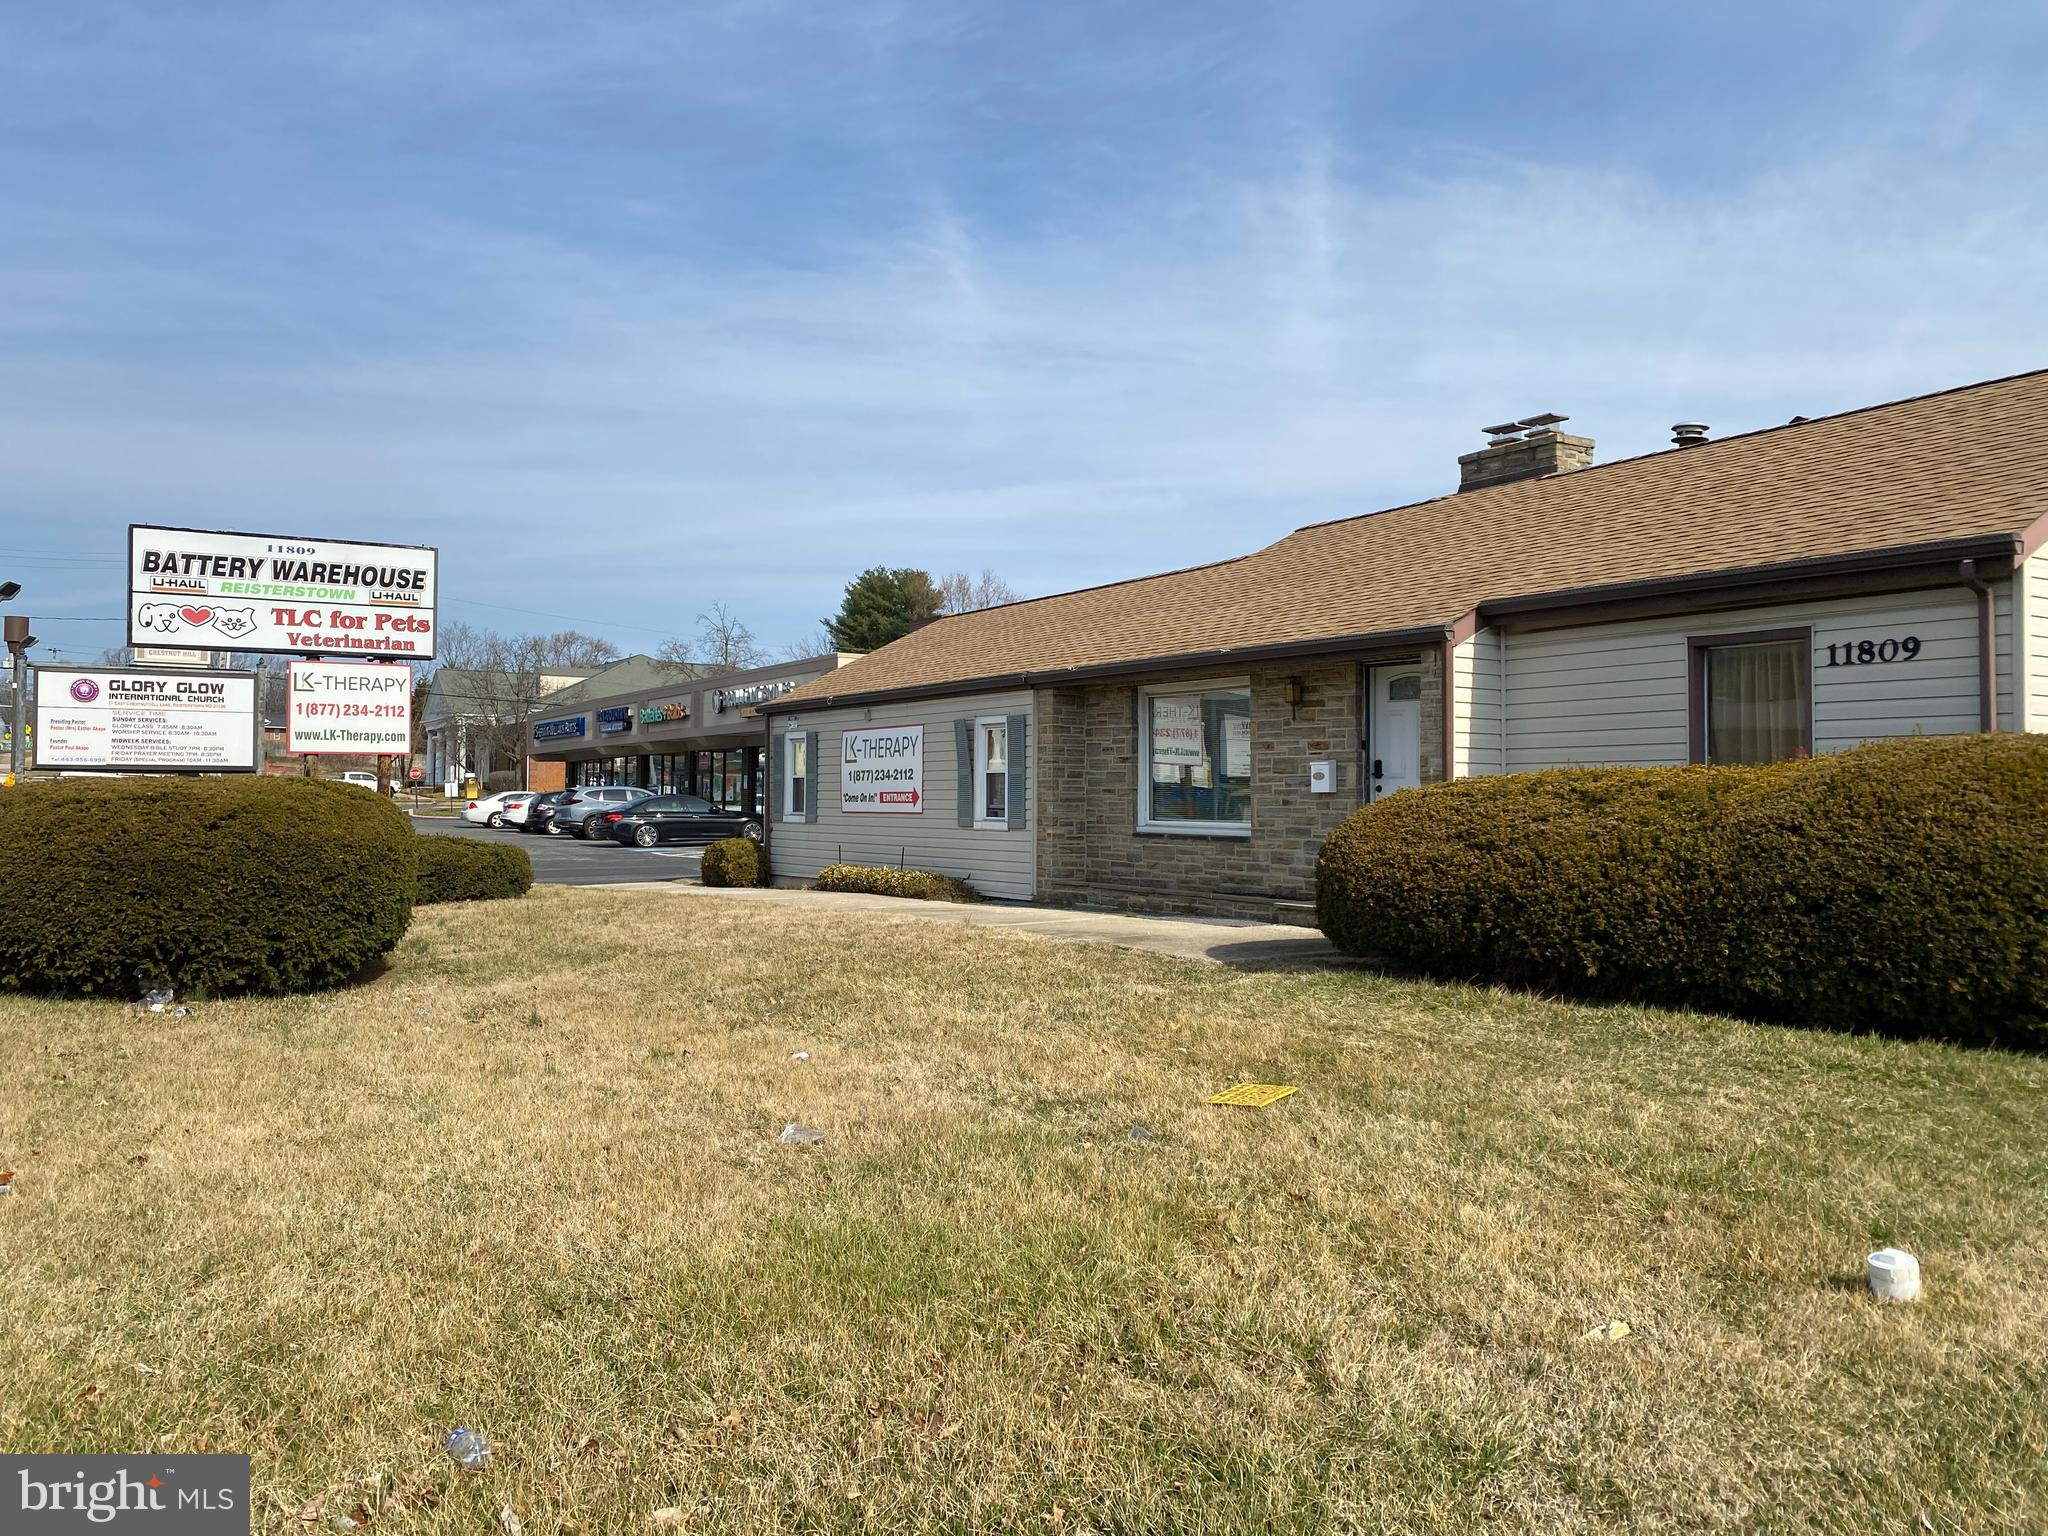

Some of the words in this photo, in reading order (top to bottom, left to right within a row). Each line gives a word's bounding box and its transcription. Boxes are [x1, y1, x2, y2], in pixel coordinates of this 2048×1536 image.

[266, 544, 316, 555] 11809
[142, 550, 267, 579] BATTERY
[271, 558, 427, 590] WAREHOUSE
[152, 577, 206, 589] U-HAUL
[220, 581, 357, 600] REISTERSTOWN
[371, 591, 419, 602] U-HAUL
[271, 608, 322, 628] TLC
[329, 610, 367, 630] for
[374, 613, 431, 633] Pets
[286, 632, 416, 651] Veterinarian
[148, 649, 181, 657] CHESTNUT
[1827, 636, 1921, 667] 11809
[108, 679, 168, 693] GLORY
[176, 682, 225, 695] GLOW
[293, 671, 407, 693] LK-THERAPY
[108, 693, 183, 702] INTERNATIONAL
[187, 695, 225, 703] CHURCH
[343, 703, 405, 718] 234-2112
[294, 728, 406, 744] www.LK-Therapy.com
[844, 735, 919, 764] LK-THERAPY
[860, 792, 868, 803] On
[882, 793, 913, 802] ENTRANCE
